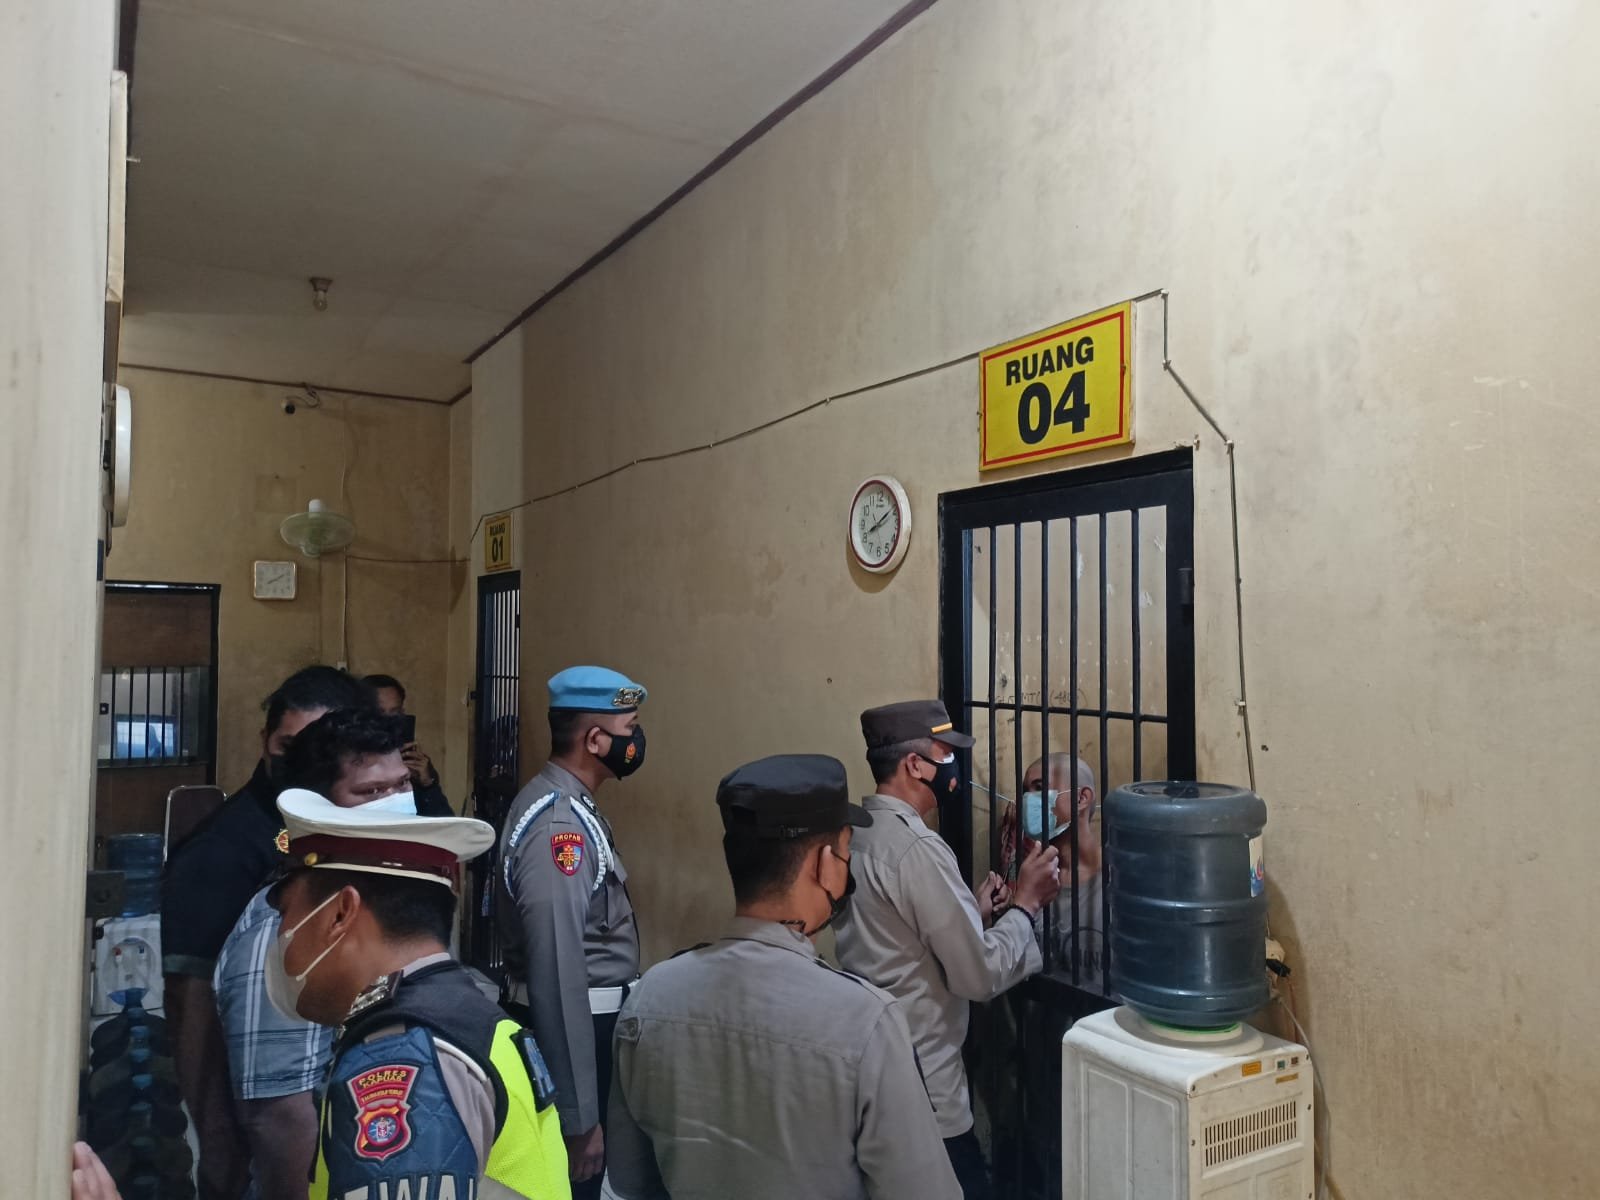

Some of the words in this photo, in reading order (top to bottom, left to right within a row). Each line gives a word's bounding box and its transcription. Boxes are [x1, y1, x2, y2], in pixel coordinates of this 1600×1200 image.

[1006, 336, 1094, 386] RUANG
[1018, 370, 1090, 444] 04
[869, 496, 875, 506] 11
[864, 505, 869, 516] 10
[861, 519, 866, 530] 9
[863, 532, 868, 543] 8
[492, 536, 504, 562] 01
[868, 543, 873, 553] 7
[876, 547, 882, 557] 6
[884, 543, 890, 554] 5
[358, 1070, 407, 1087] POLRES
